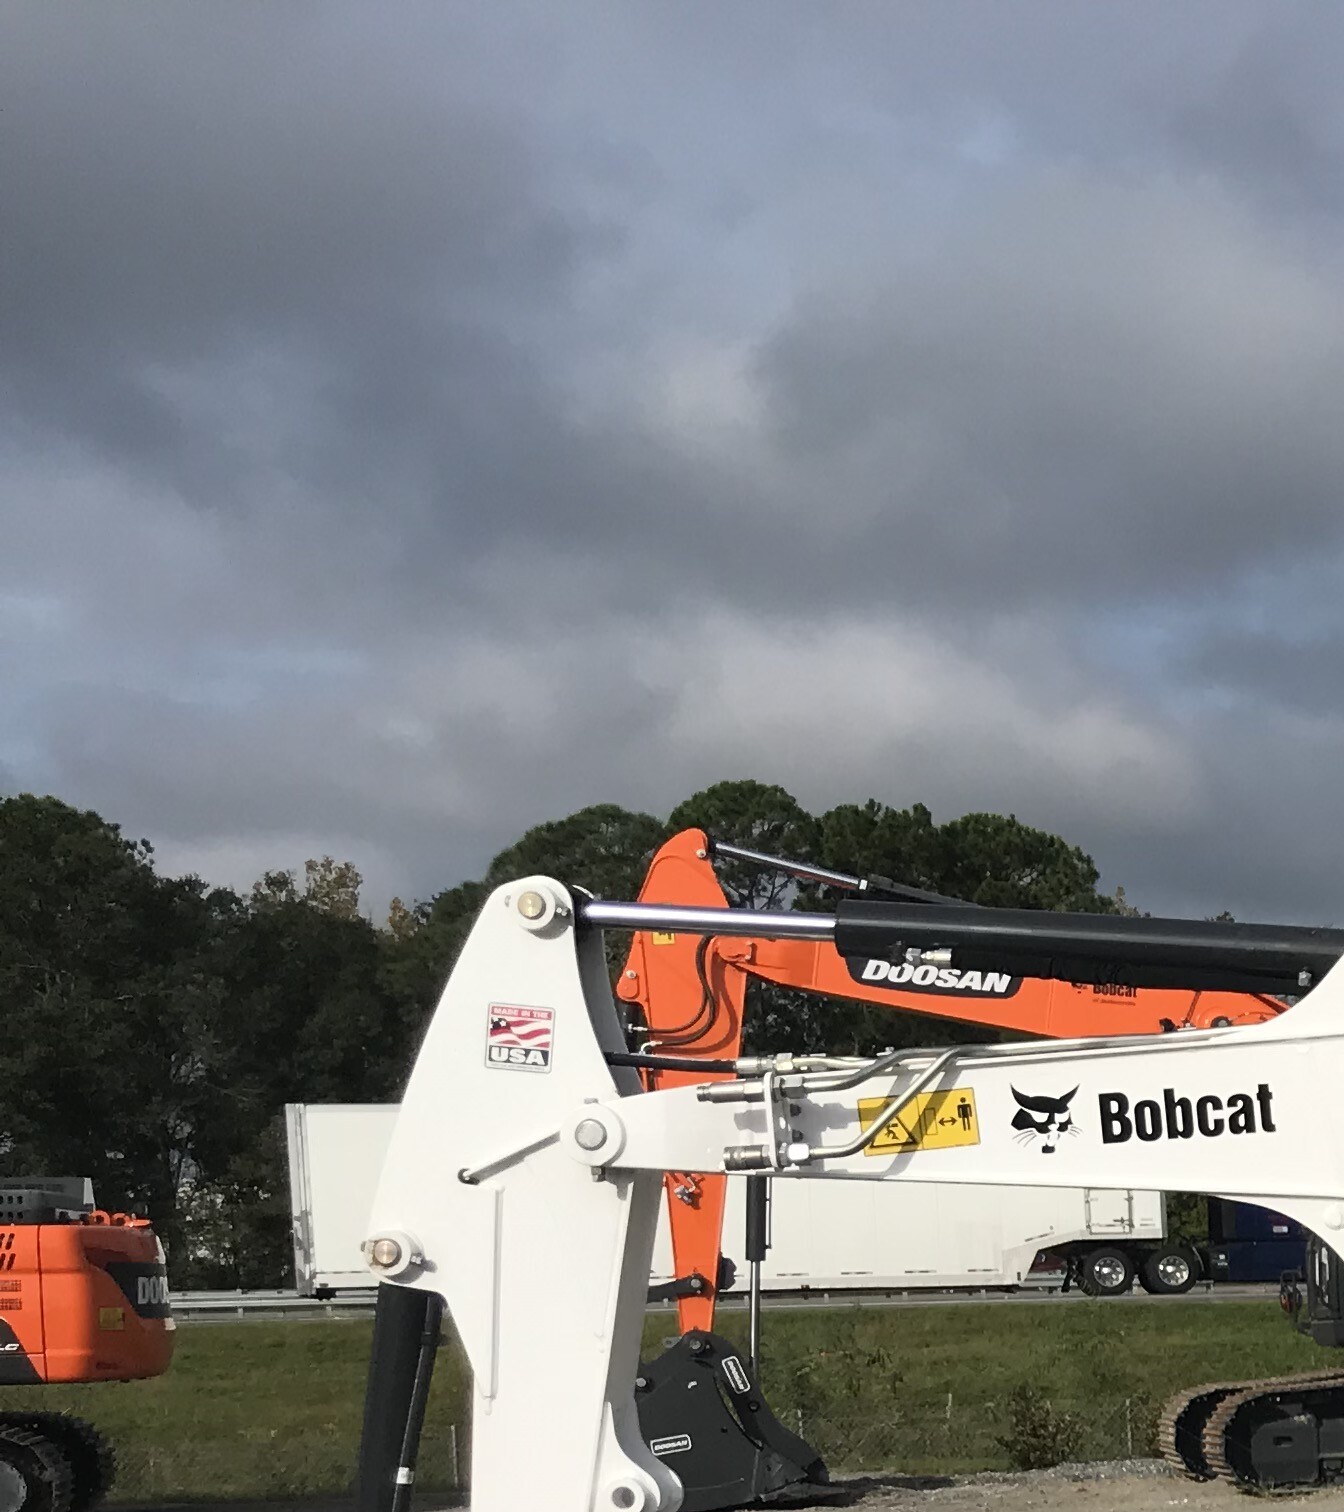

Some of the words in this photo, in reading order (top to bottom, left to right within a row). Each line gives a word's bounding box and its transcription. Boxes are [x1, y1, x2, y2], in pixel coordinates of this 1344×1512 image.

[862, 959, 1012, 993] DOOSAN
[490, 1046, 546, 1066] USA
[1098, 1083, 1277, 1145] Bobcat
